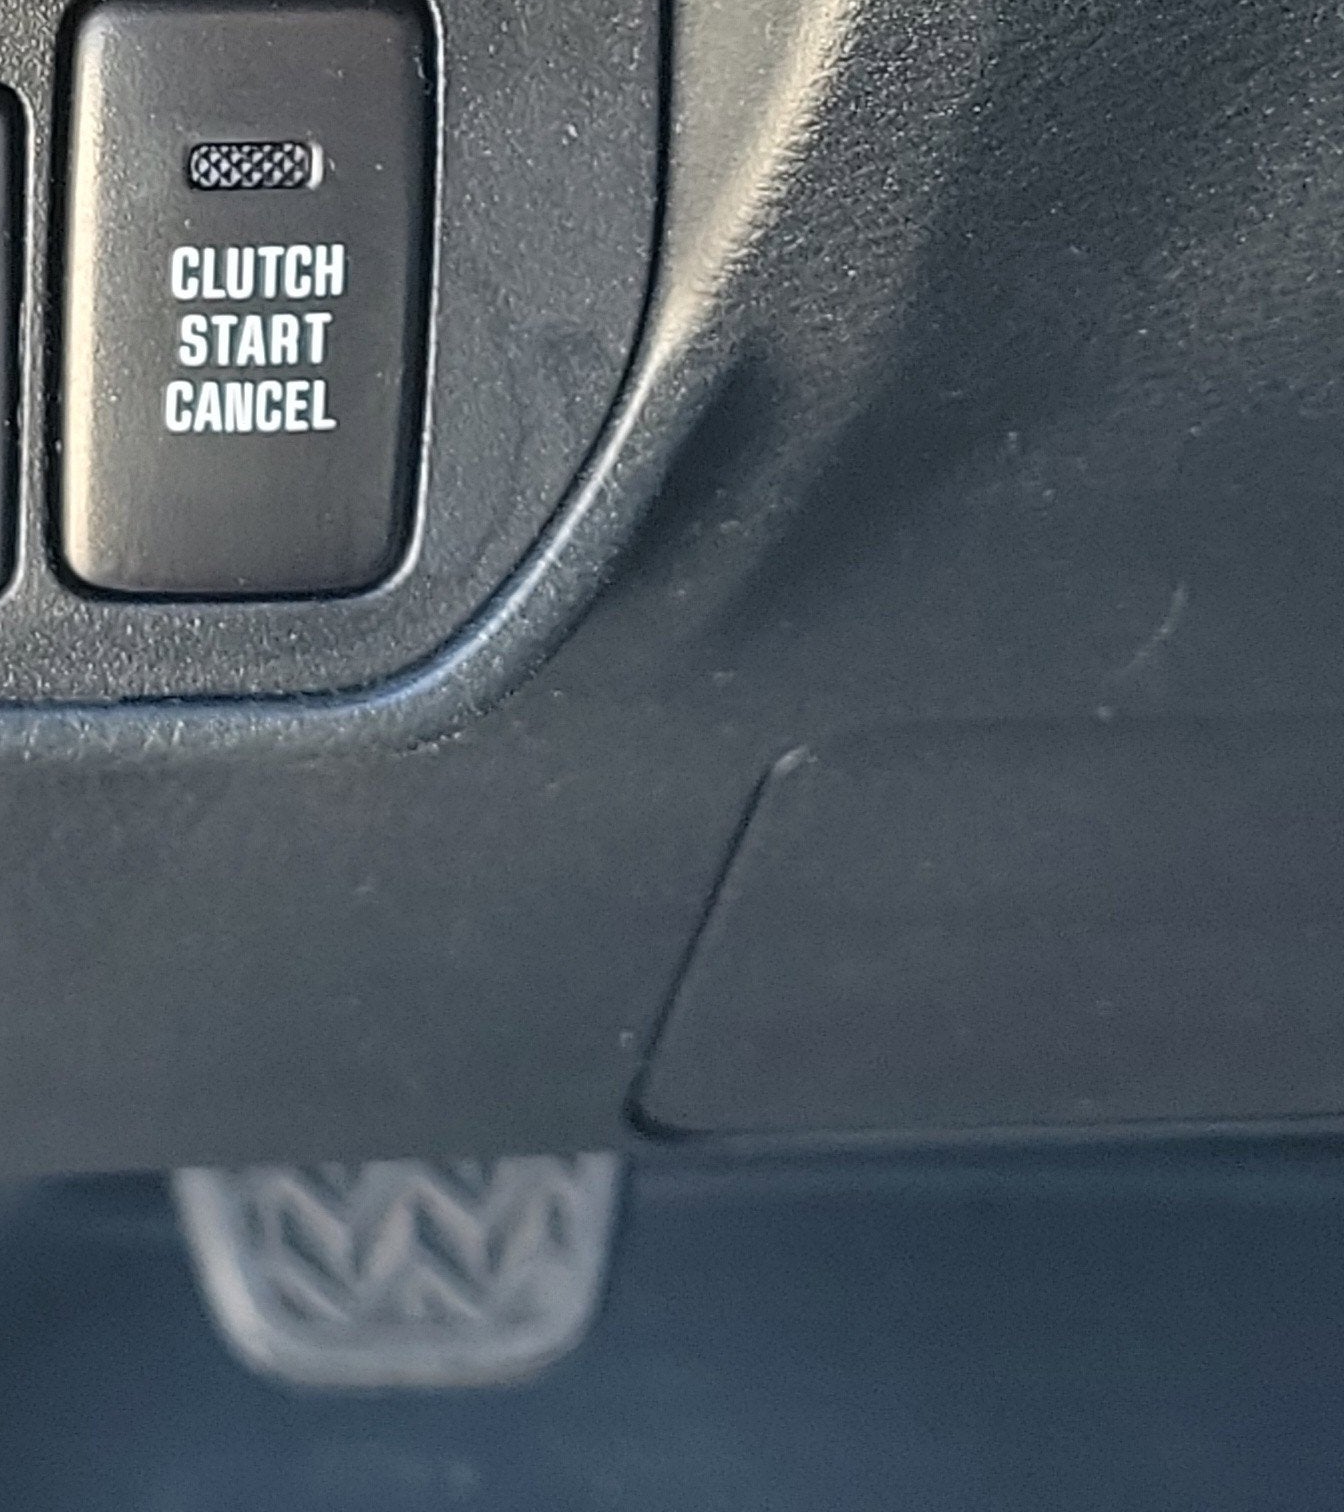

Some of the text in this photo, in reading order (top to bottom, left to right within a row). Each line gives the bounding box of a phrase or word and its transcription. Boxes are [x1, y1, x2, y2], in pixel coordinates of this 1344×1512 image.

[171, 244, 345, 300] CLUTCH
[179, 312, 333, 367] START
[165, 380, 337, 433] CANCEL
